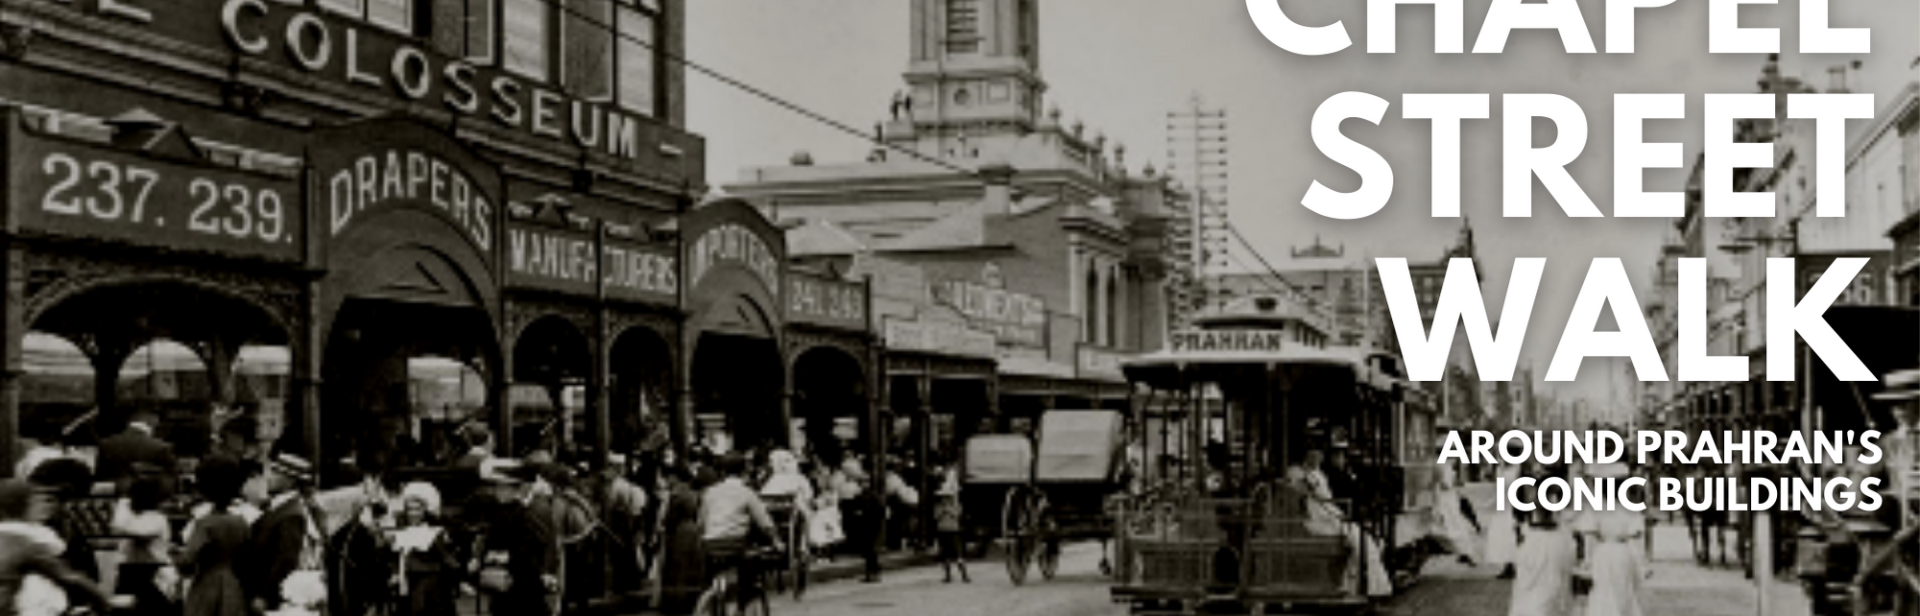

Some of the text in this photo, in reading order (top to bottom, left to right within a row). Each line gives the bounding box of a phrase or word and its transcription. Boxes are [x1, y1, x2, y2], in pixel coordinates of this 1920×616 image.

[221, 0, 639, 159] COLOSSEUM
[330, 150, 490, 252] DRAPERS
[1171, 331, 1281, 352] PRAHRAN
